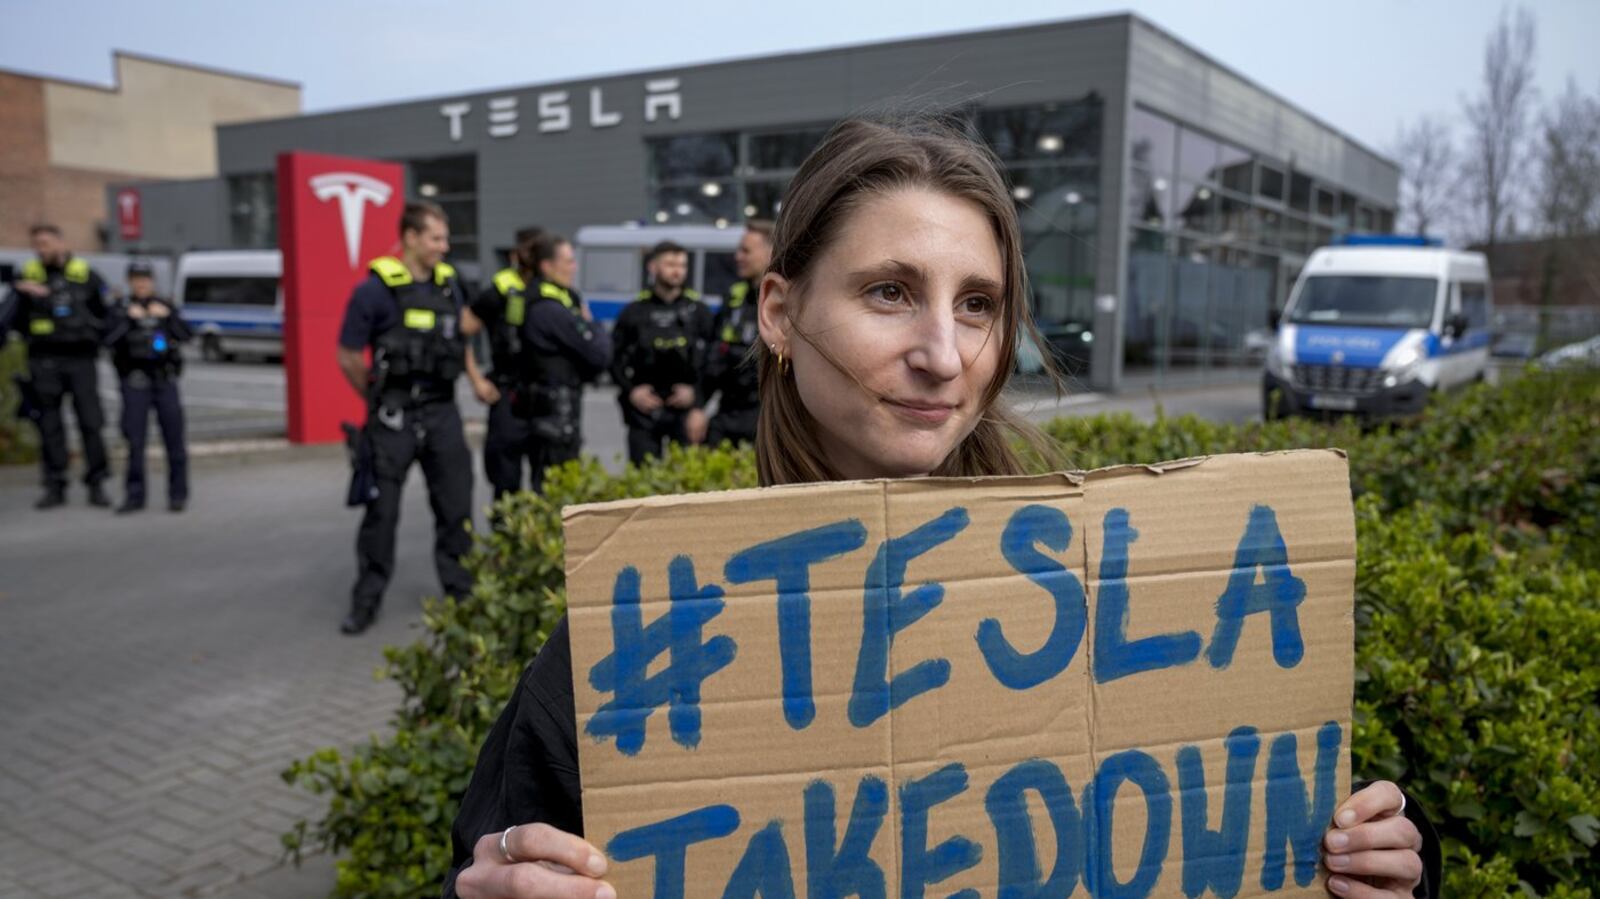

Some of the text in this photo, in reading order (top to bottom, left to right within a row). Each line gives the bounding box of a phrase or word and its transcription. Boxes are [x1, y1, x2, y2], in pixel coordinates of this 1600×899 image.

[440, 77, 682, 141] TESLA
[584, 504, 1307, 757] #TESLA
[606, 720, 1342, 899] TAKEDOWN
